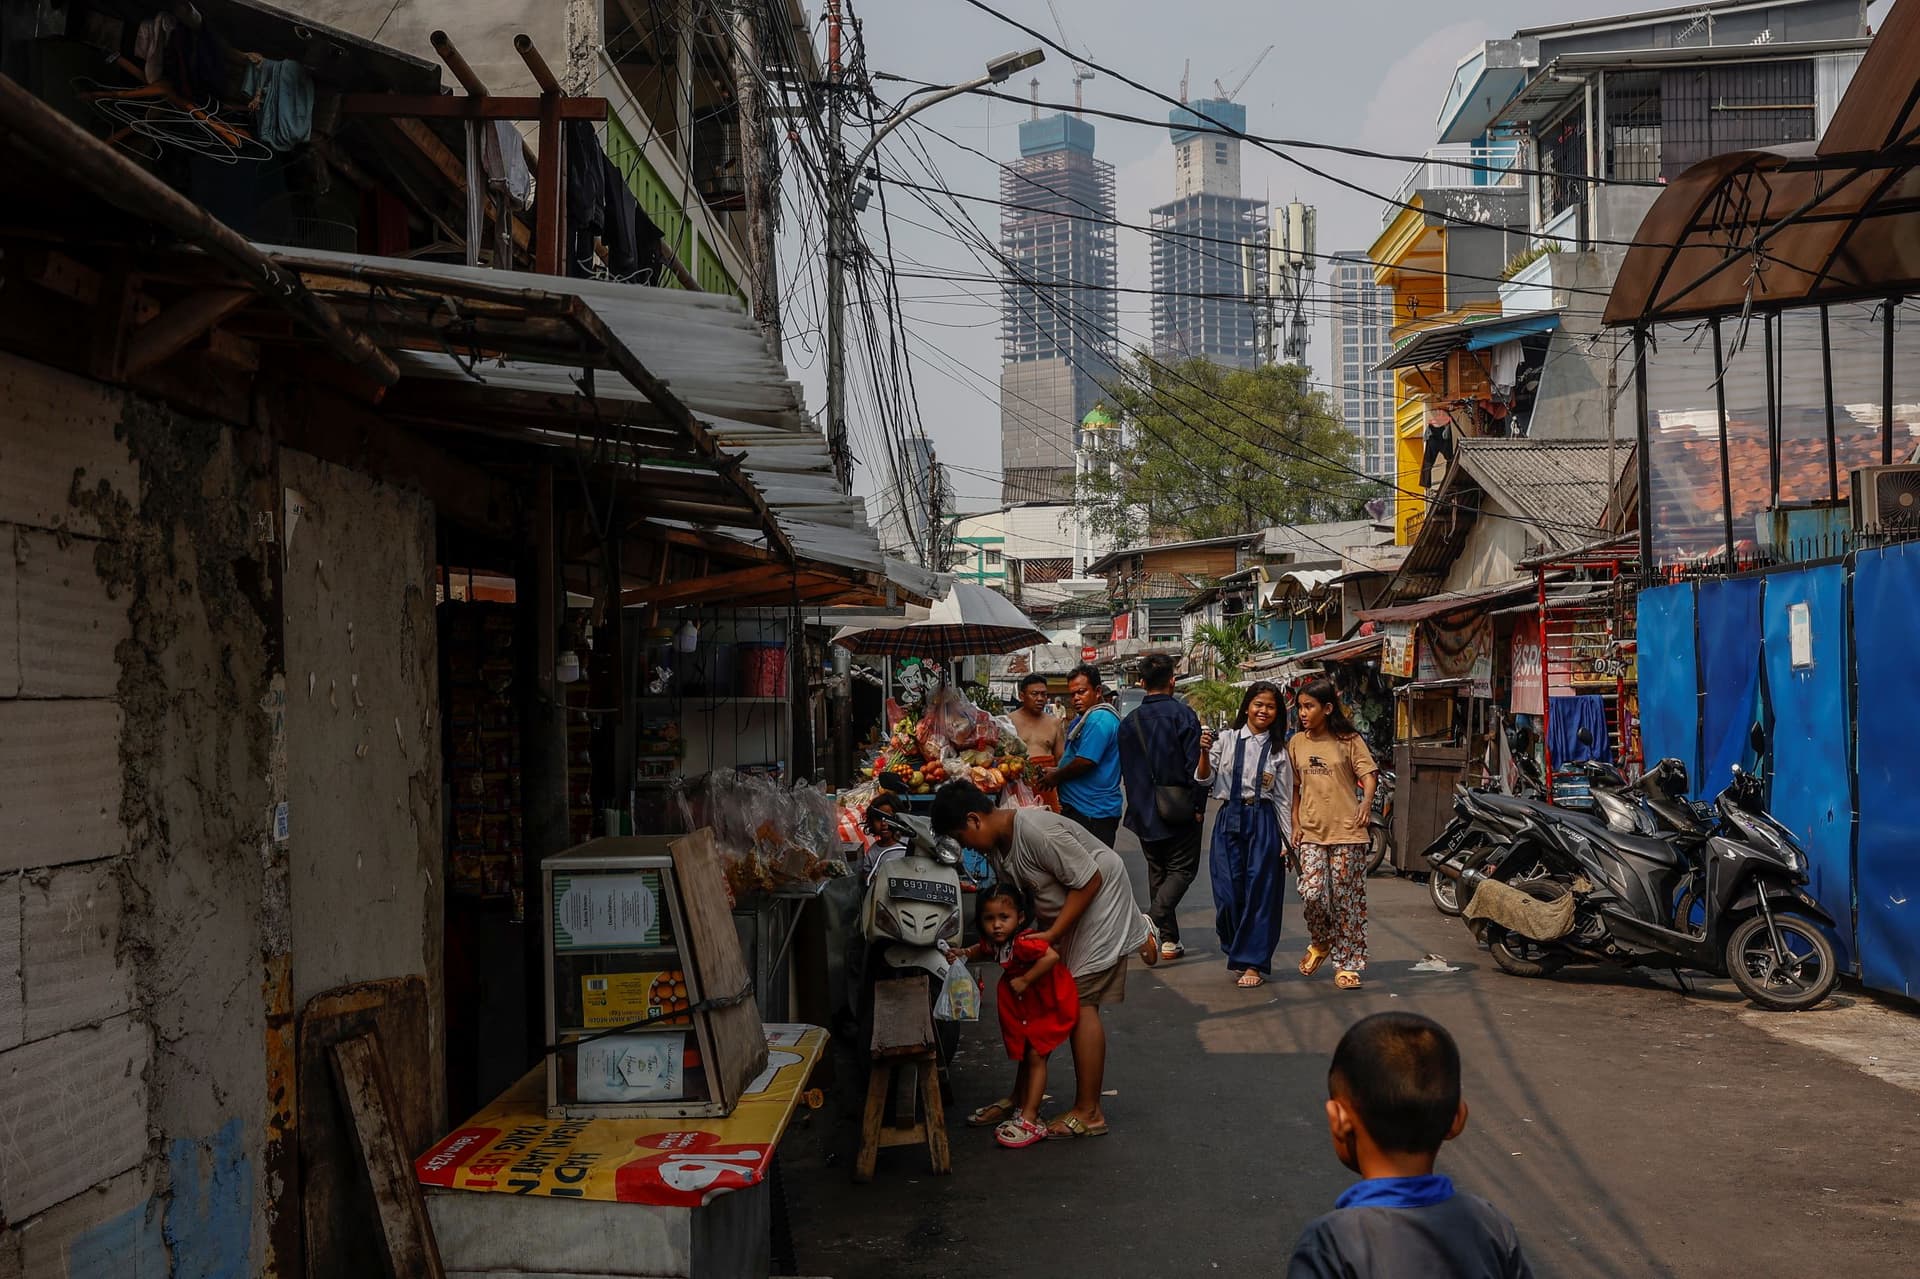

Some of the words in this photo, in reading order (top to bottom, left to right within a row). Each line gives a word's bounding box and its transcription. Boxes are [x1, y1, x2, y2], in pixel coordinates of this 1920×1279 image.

[1594, 658, 1626, 677] OJEK
[890, 879, 897, 887] B
[903, 880, 929, 890] 6937
[935, 883, 955, 896] PJW
[494, 1126, 545, 1151] YANG
[466, 1152, 520, 1187] LEBI
[549, 1153, 600, 1196] HADI
